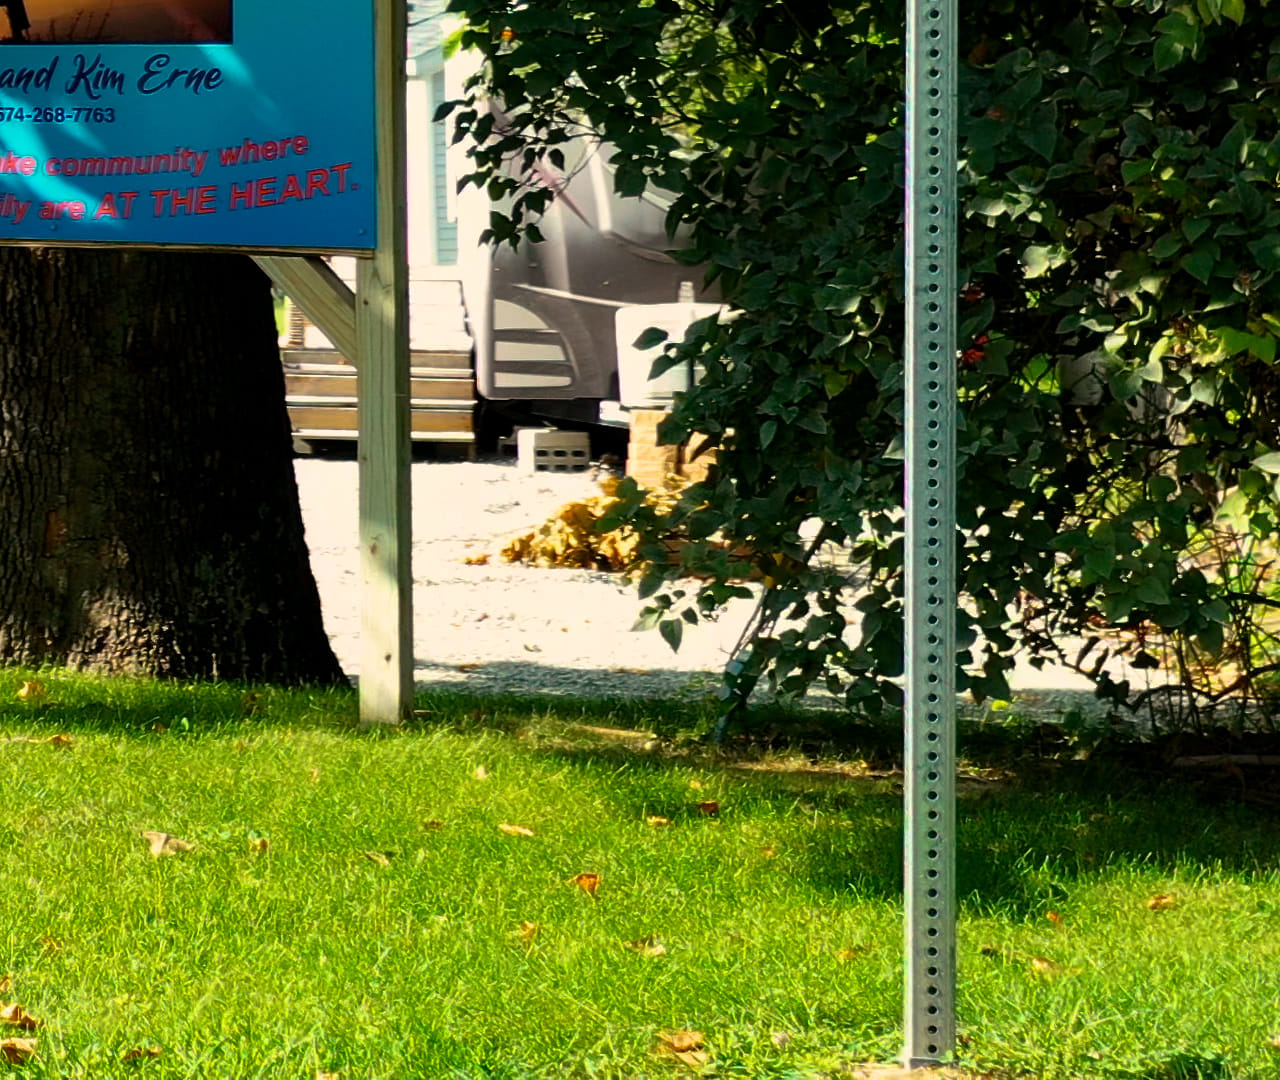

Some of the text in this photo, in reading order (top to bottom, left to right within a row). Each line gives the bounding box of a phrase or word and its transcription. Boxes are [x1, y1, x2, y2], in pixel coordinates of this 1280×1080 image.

[65, 53, 125, 100] Kim
[137, 53, 224, 95] Erne
[45, 146, 209, 176] community
[218, 134, 310, 167] where
[39, 199, 85, 221] are
[94, 191, 139, 220] AT
[150, 184, 218, 218] THE
[230, 162, 360, 211] HEART.
